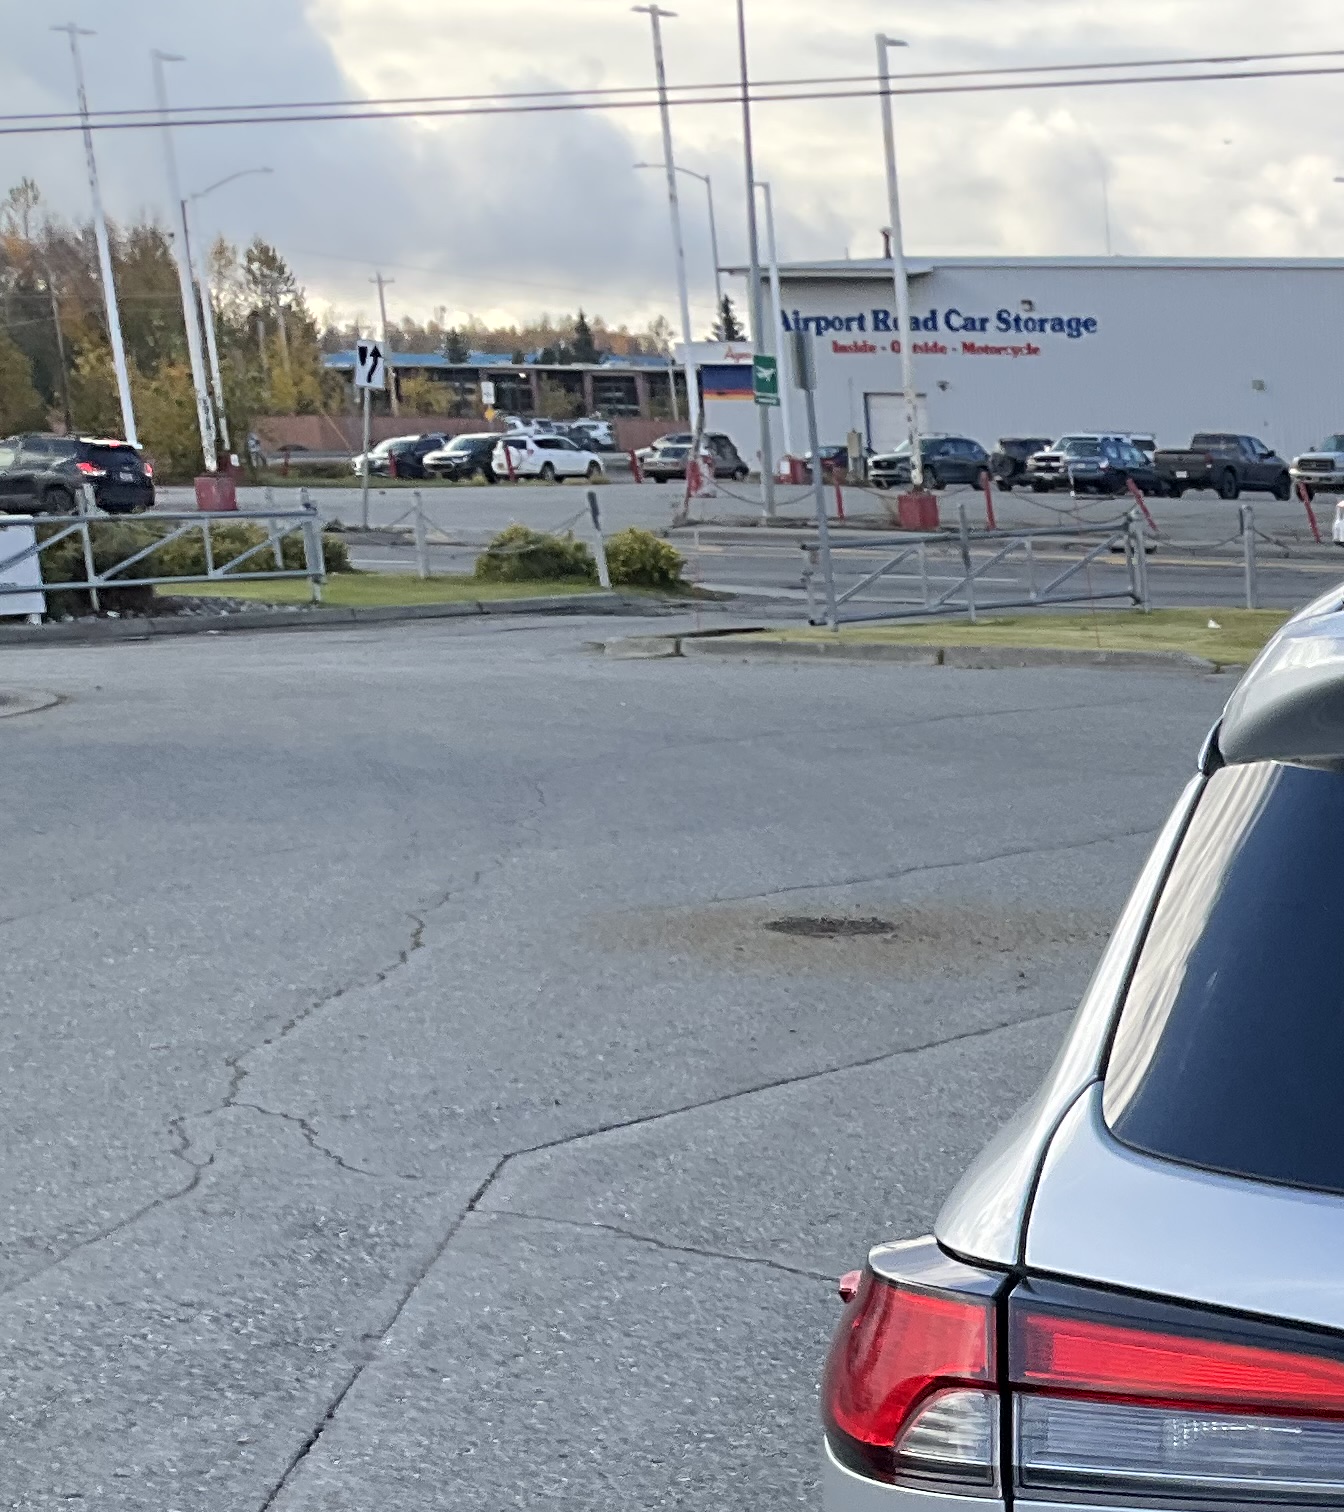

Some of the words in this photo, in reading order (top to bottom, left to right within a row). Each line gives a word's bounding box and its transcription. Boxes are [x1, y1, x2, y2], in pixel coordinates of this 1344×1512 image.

[944, 309, 989, 333] Car
[995, 309, 1097, 339] Storage
[890, 340, 948, 355] Otside
